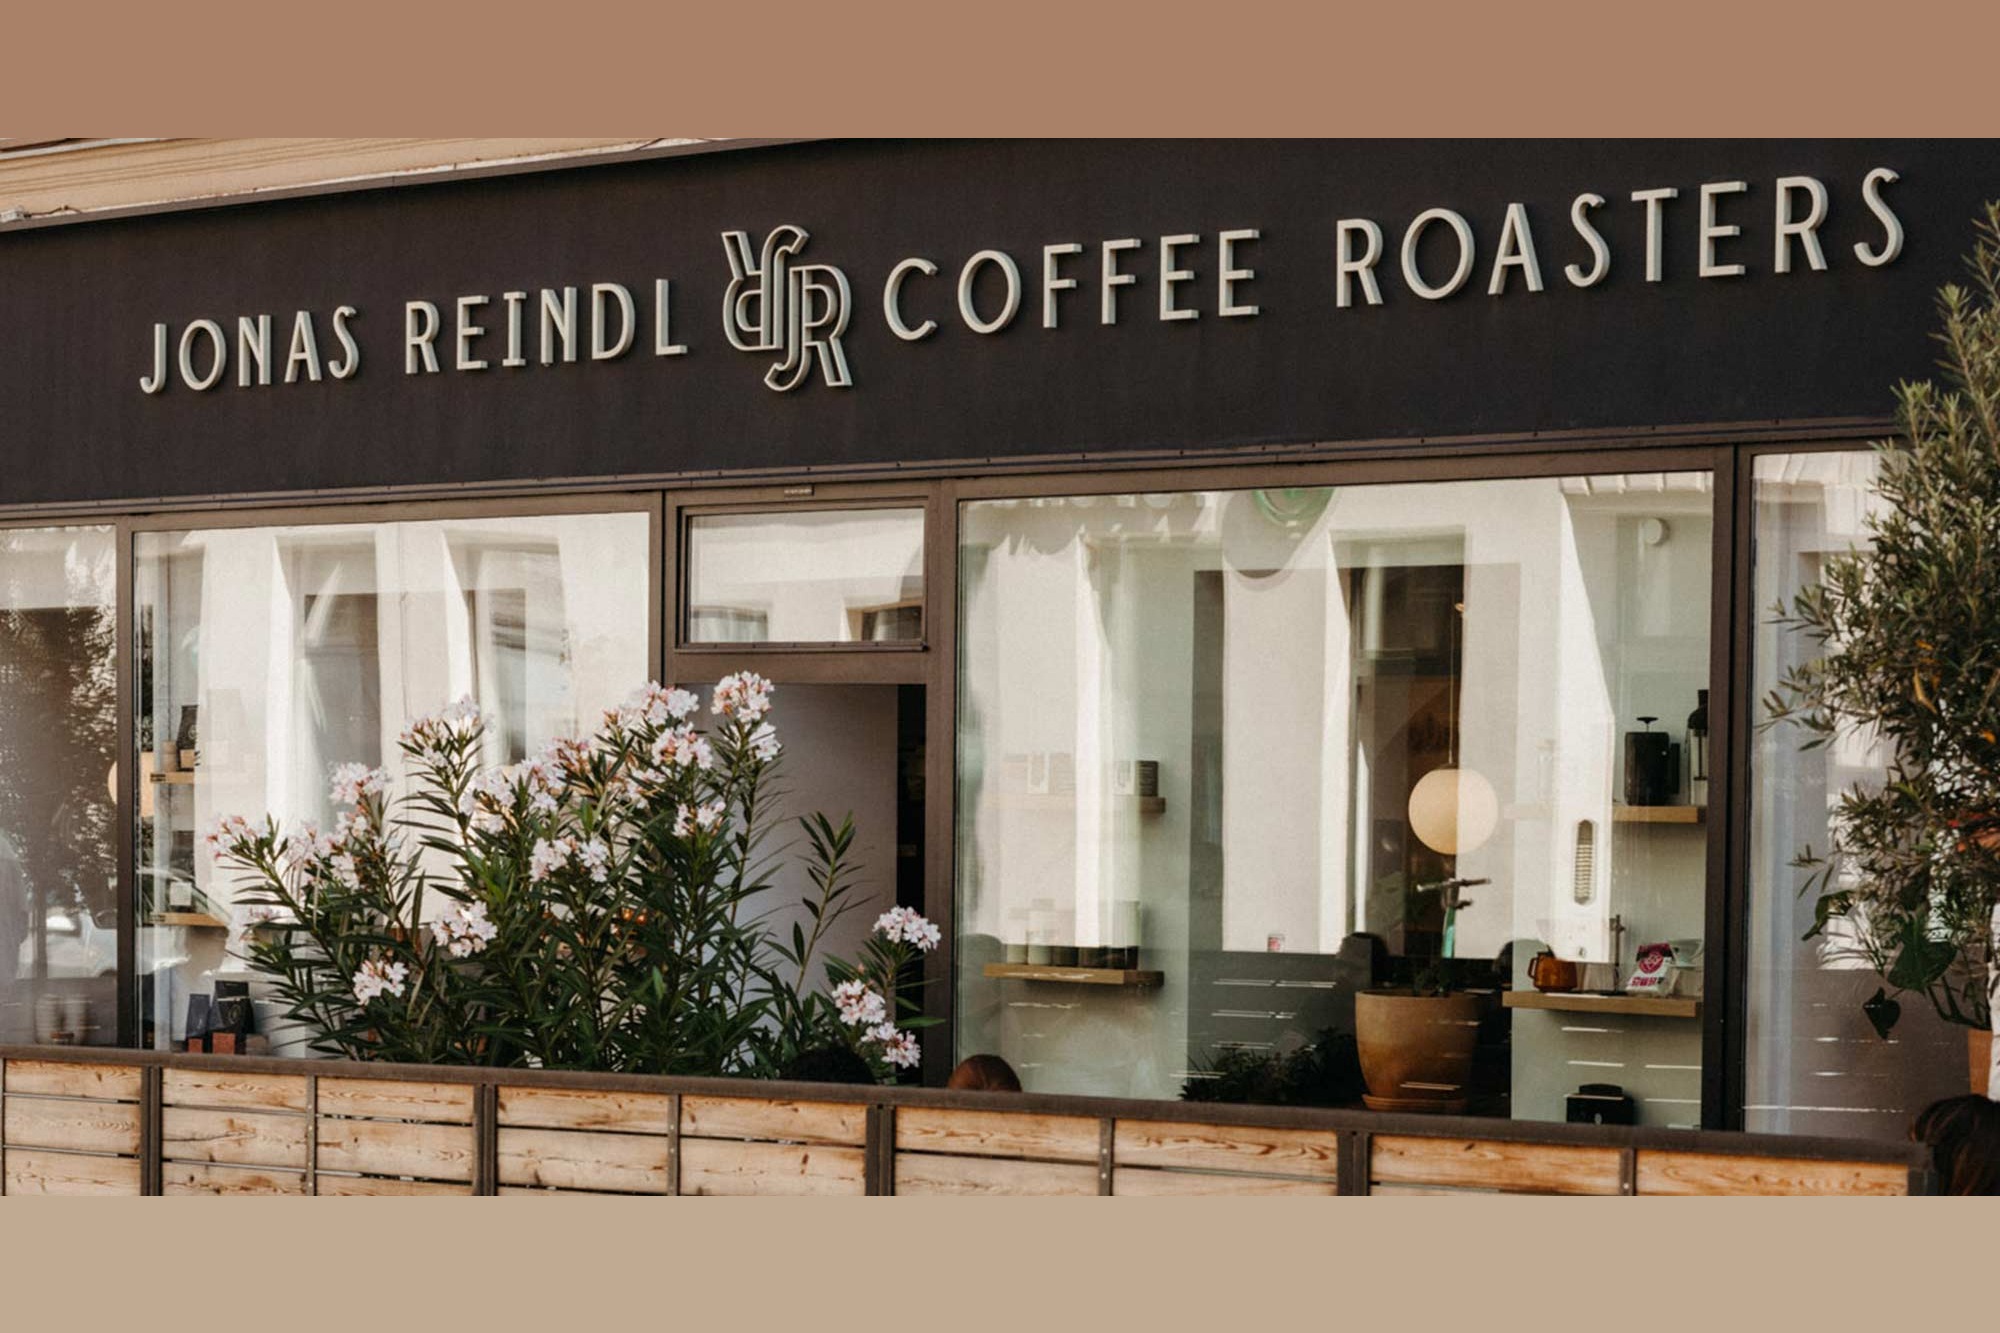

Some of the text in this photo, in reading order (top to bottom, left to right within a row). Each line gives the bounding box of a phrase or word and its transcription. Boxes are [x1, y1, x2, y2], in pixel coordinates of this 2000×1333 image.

[140, 168, 1904, 393] JONAS REINDL COFFEE ROASTERS
